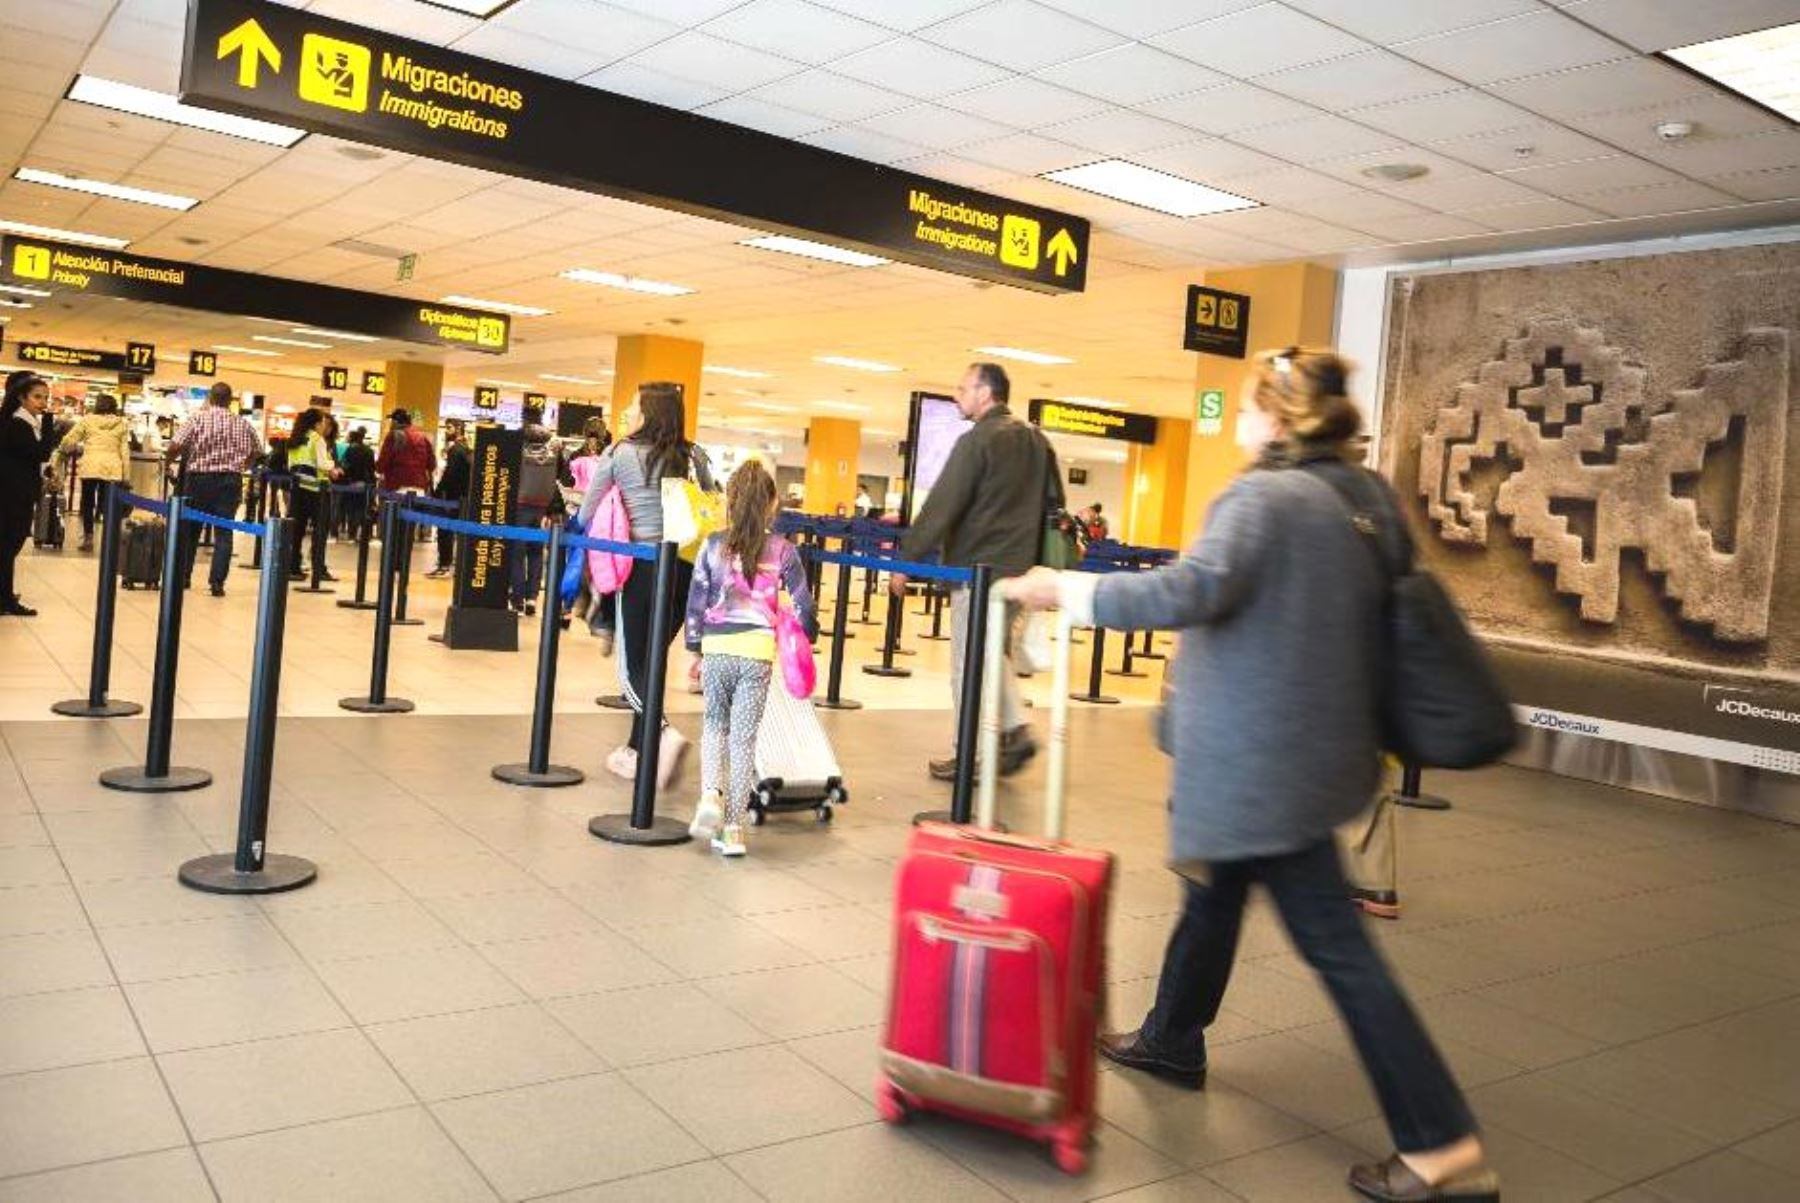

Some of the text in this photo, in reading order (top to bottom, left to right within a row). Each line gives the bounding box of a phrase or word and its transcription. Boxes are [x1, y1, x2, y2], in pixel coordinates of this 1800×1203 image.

[382, 52, 523, 110] Migraciones
[379, 89, 508, 138] Immigrations
[909, 190, 999, 231] Migraciones
[915, 221, 997, 256] Immigrations
[28, 254, 36, 273] 1
[53, 251, 184, 285] Atención Preferencial
[52, 270, 91, 290] Priority
[131, 347, 151, 366] 17
[194, 355, 214, 373] 18
[328, 370, 345, 388] 19
[480, 390, 496, 406] 21
[1202, 391, 1222, 417] S
[471, 540, 490, 588] Entrada
[482, 443, 499, 506] pasajeros
[1529, 712, 1600, 734] JCDecaux
[1715, 698, 1800, 723] JCDecaux
